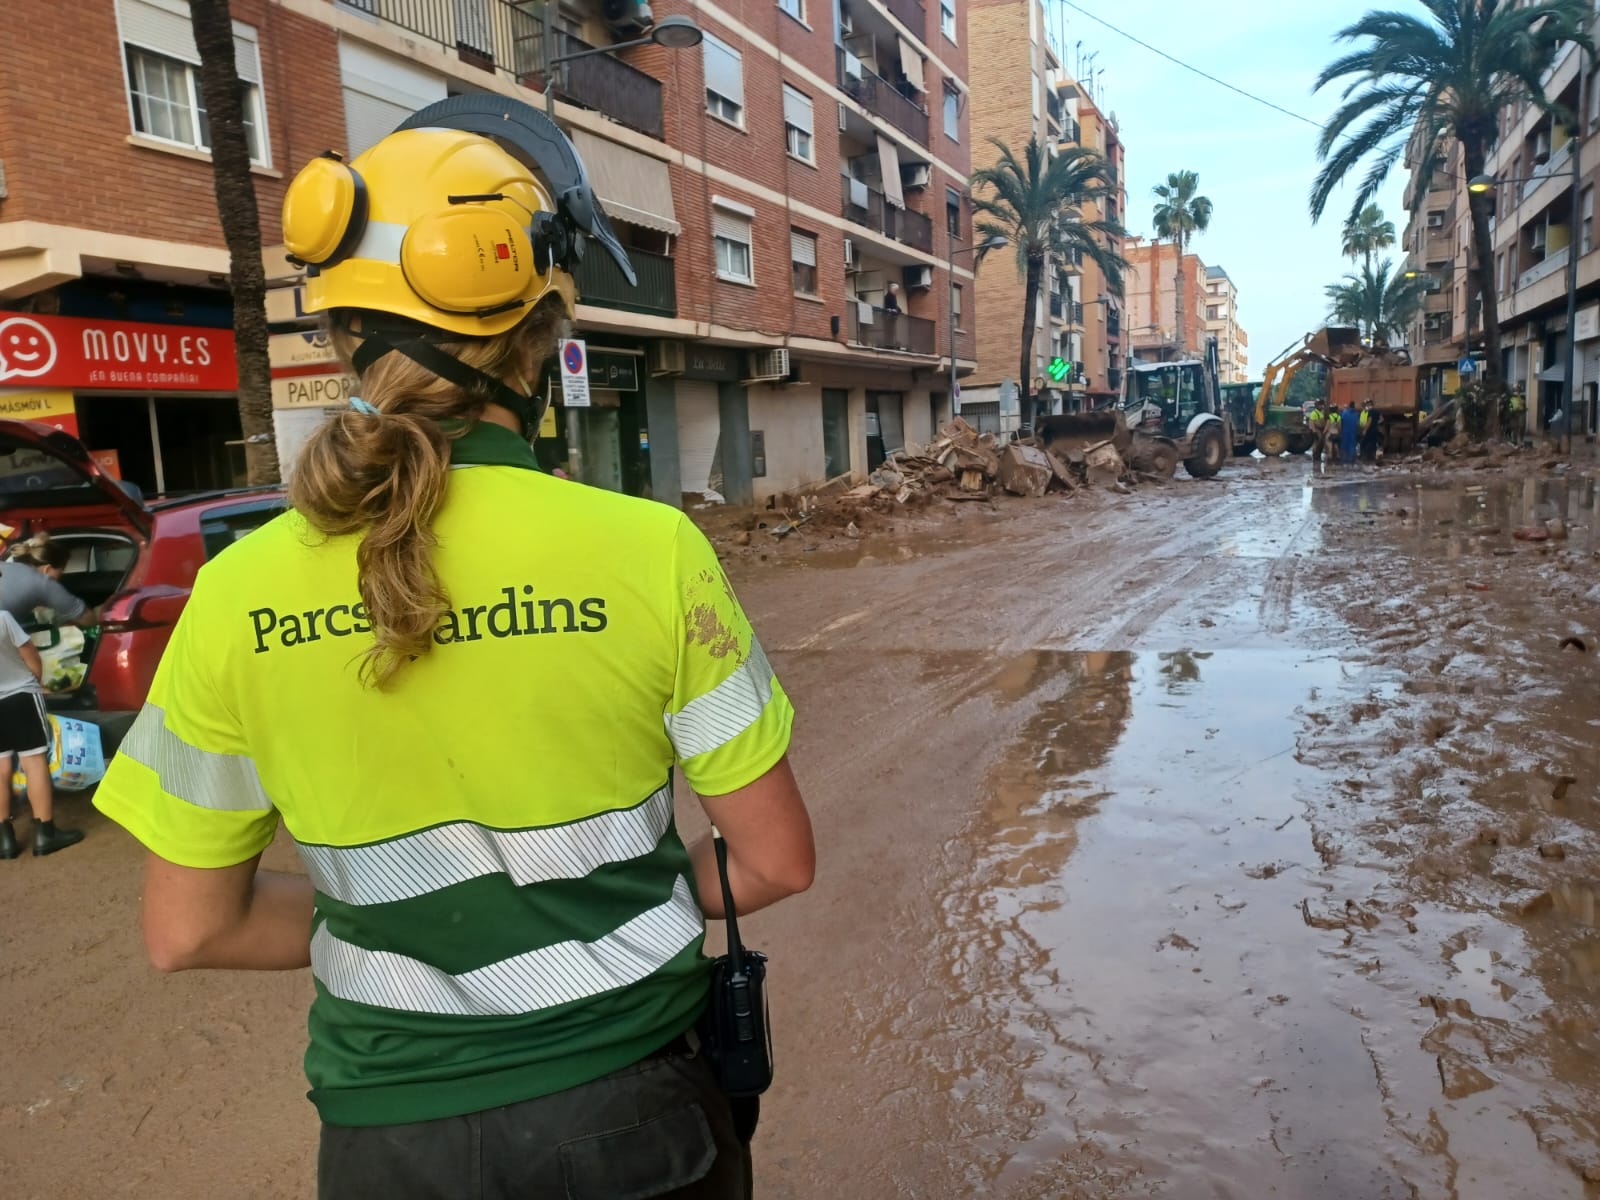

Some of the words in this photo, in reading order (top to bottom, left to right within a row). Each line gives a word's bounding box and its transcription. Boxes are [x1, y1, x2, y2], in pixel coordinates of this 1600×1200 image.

[82, 327, 211, 366] MOVY.ES
[287, 378, 352, 403] PAIPOR
[433, 584, 608, 645] ardins
